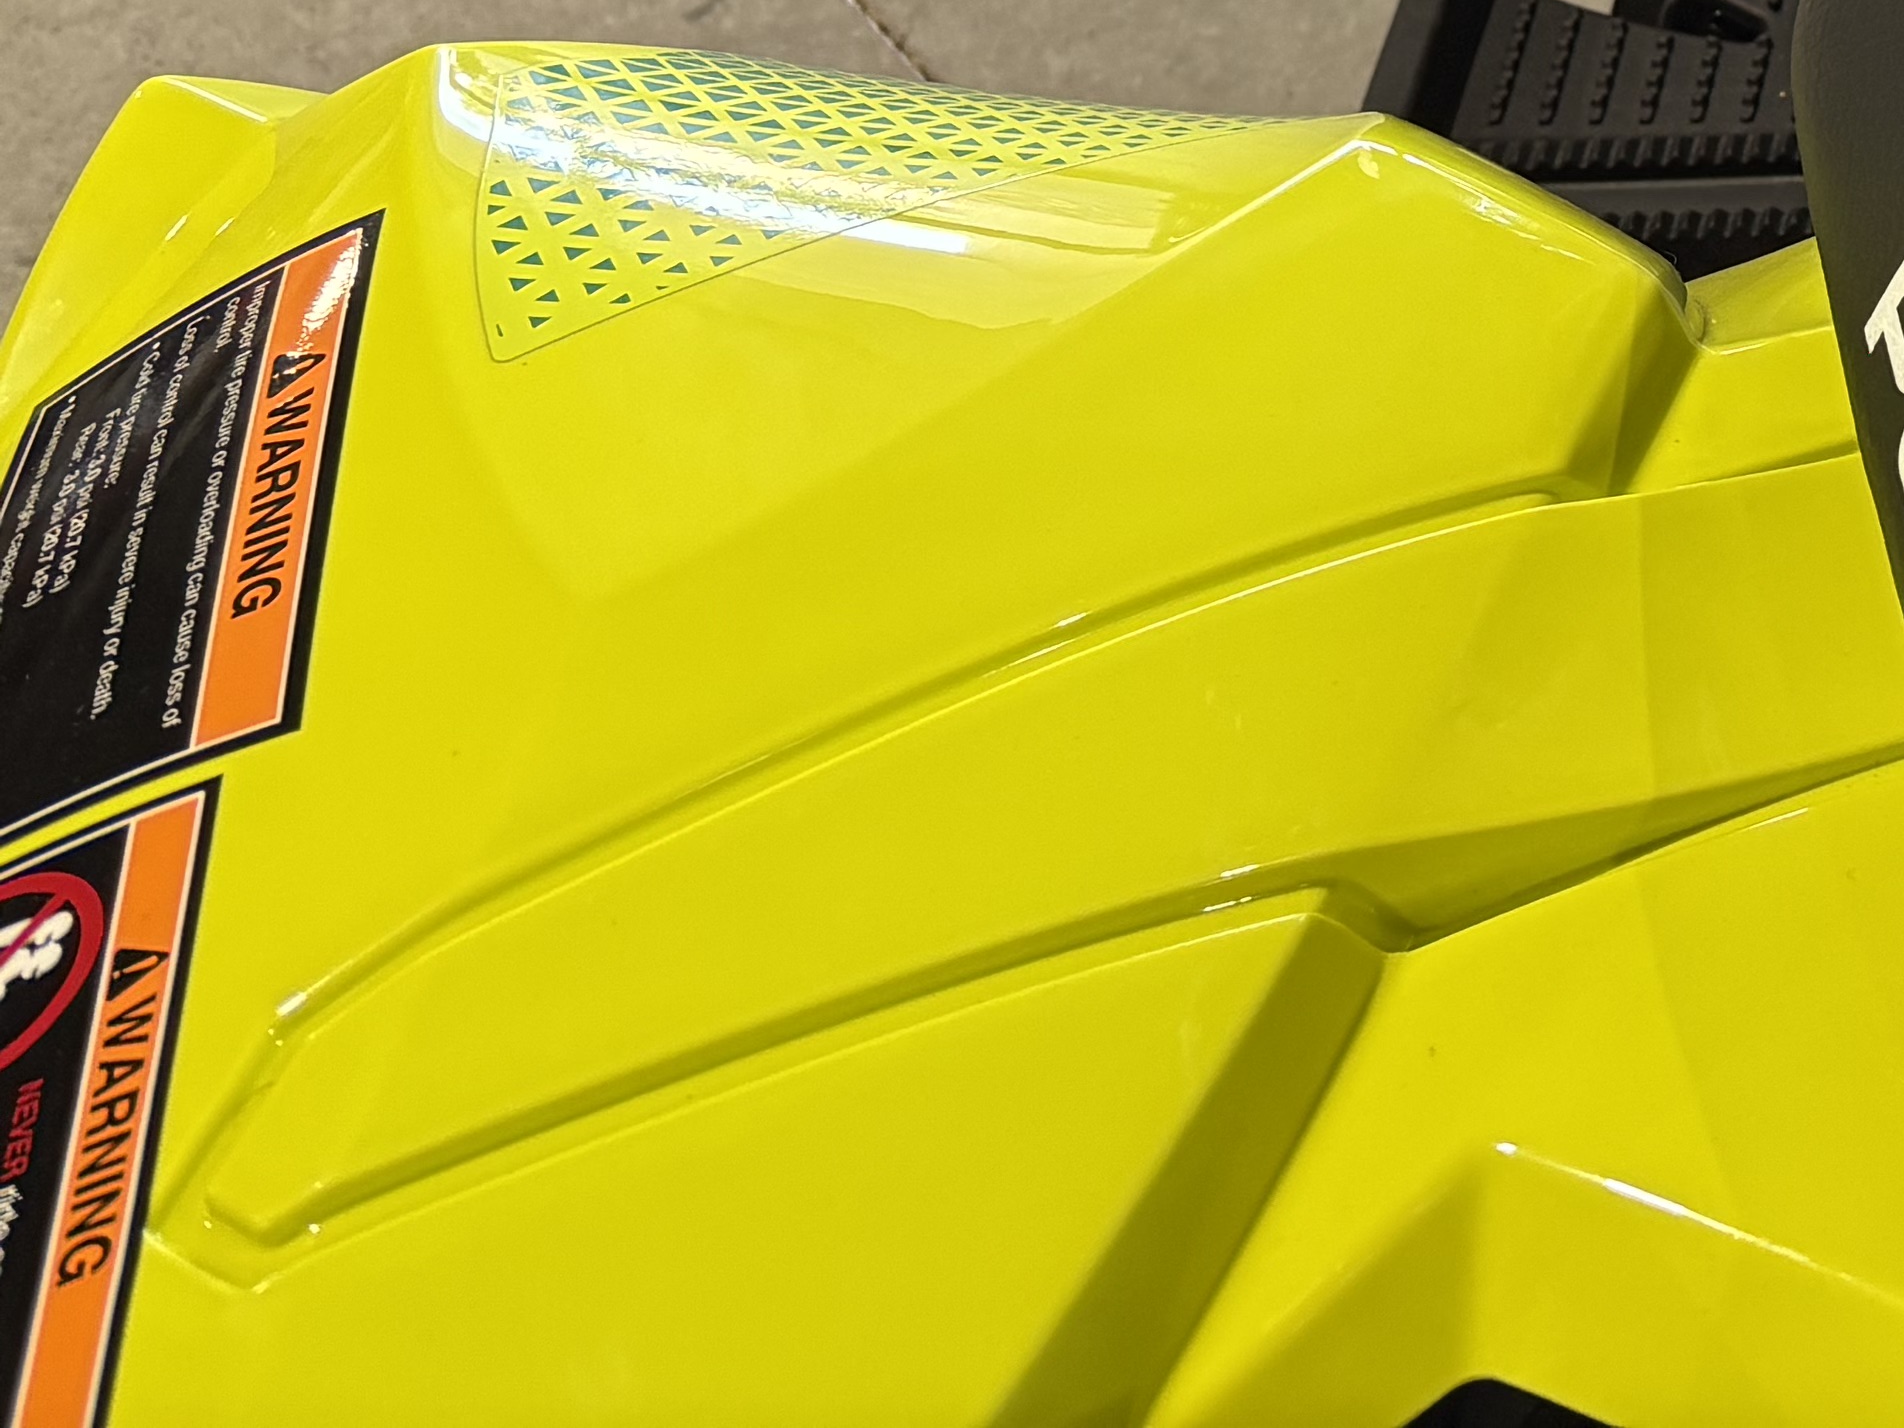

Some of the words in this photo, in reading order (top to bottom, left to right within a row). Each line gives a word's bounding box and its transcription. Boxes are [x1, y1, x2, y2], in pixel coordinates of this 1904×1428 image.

[178, 316, 205, 353] Loss
[238, 281, 270, 347] Improper
[172, 357, 190, 372] of
[231, 351, 252, 378] tire
[157, 375, 183, 427] control
[216, 380, 242, 447] pressure
[149, 429, 168, 459] can
[212, 451, 227, 467] or
[136, 462, 158, 508] result
[232, 389, 315, 620] WARNING
[132, 508, 152, 526] in
[186, 471, 224, 571] overloading
[118, 528, 144, 585] severe
[103, 585, 135, 634] injury
[185, 573, 204, 606] can
[103, 638, 120, 656] or
[173, 609, 196, 663] cause
[90, 661, 118, 720] death.
[165, 664, 190, 706] loss
[162, 708, 181, 728] of
[0, 1078, 44, 1182] NEVER
[56, 995, 160, 1287] WARNING
